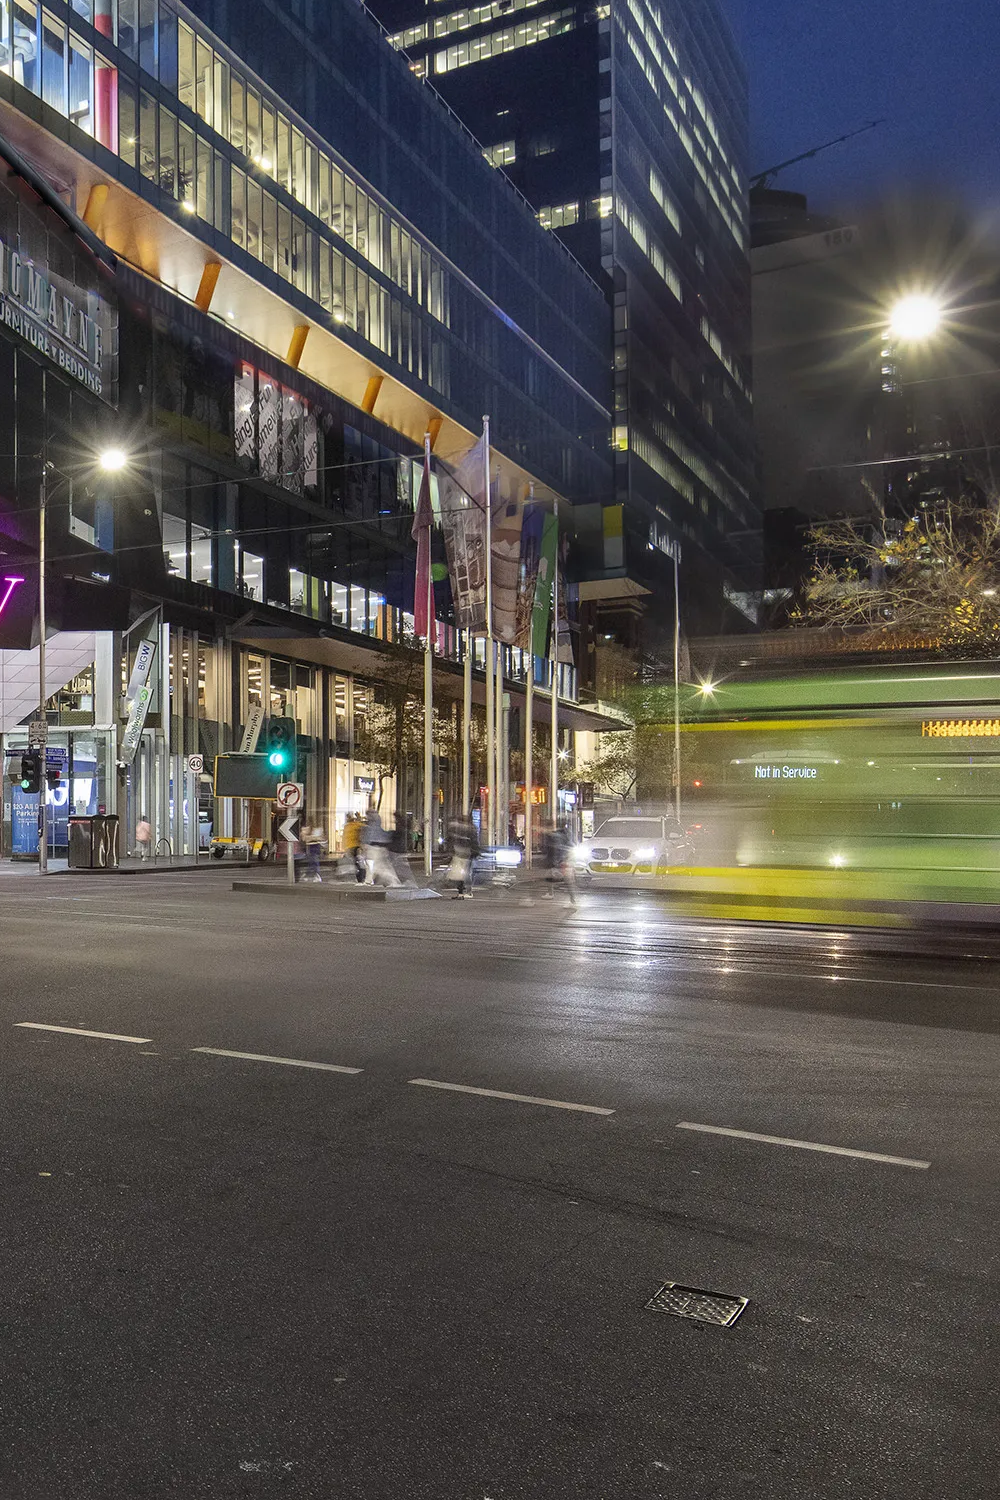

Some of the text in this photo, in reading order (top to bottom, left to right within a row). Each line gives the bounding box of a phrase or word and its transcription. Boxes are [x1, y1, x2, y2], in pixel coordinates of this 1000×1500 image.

[58, 349, 103, 394] BEDDING
[127, 702, 145, 744] Woolworths
[190, 760, 200, 768] 40
[755, 765, 817, 779] Not in Service
